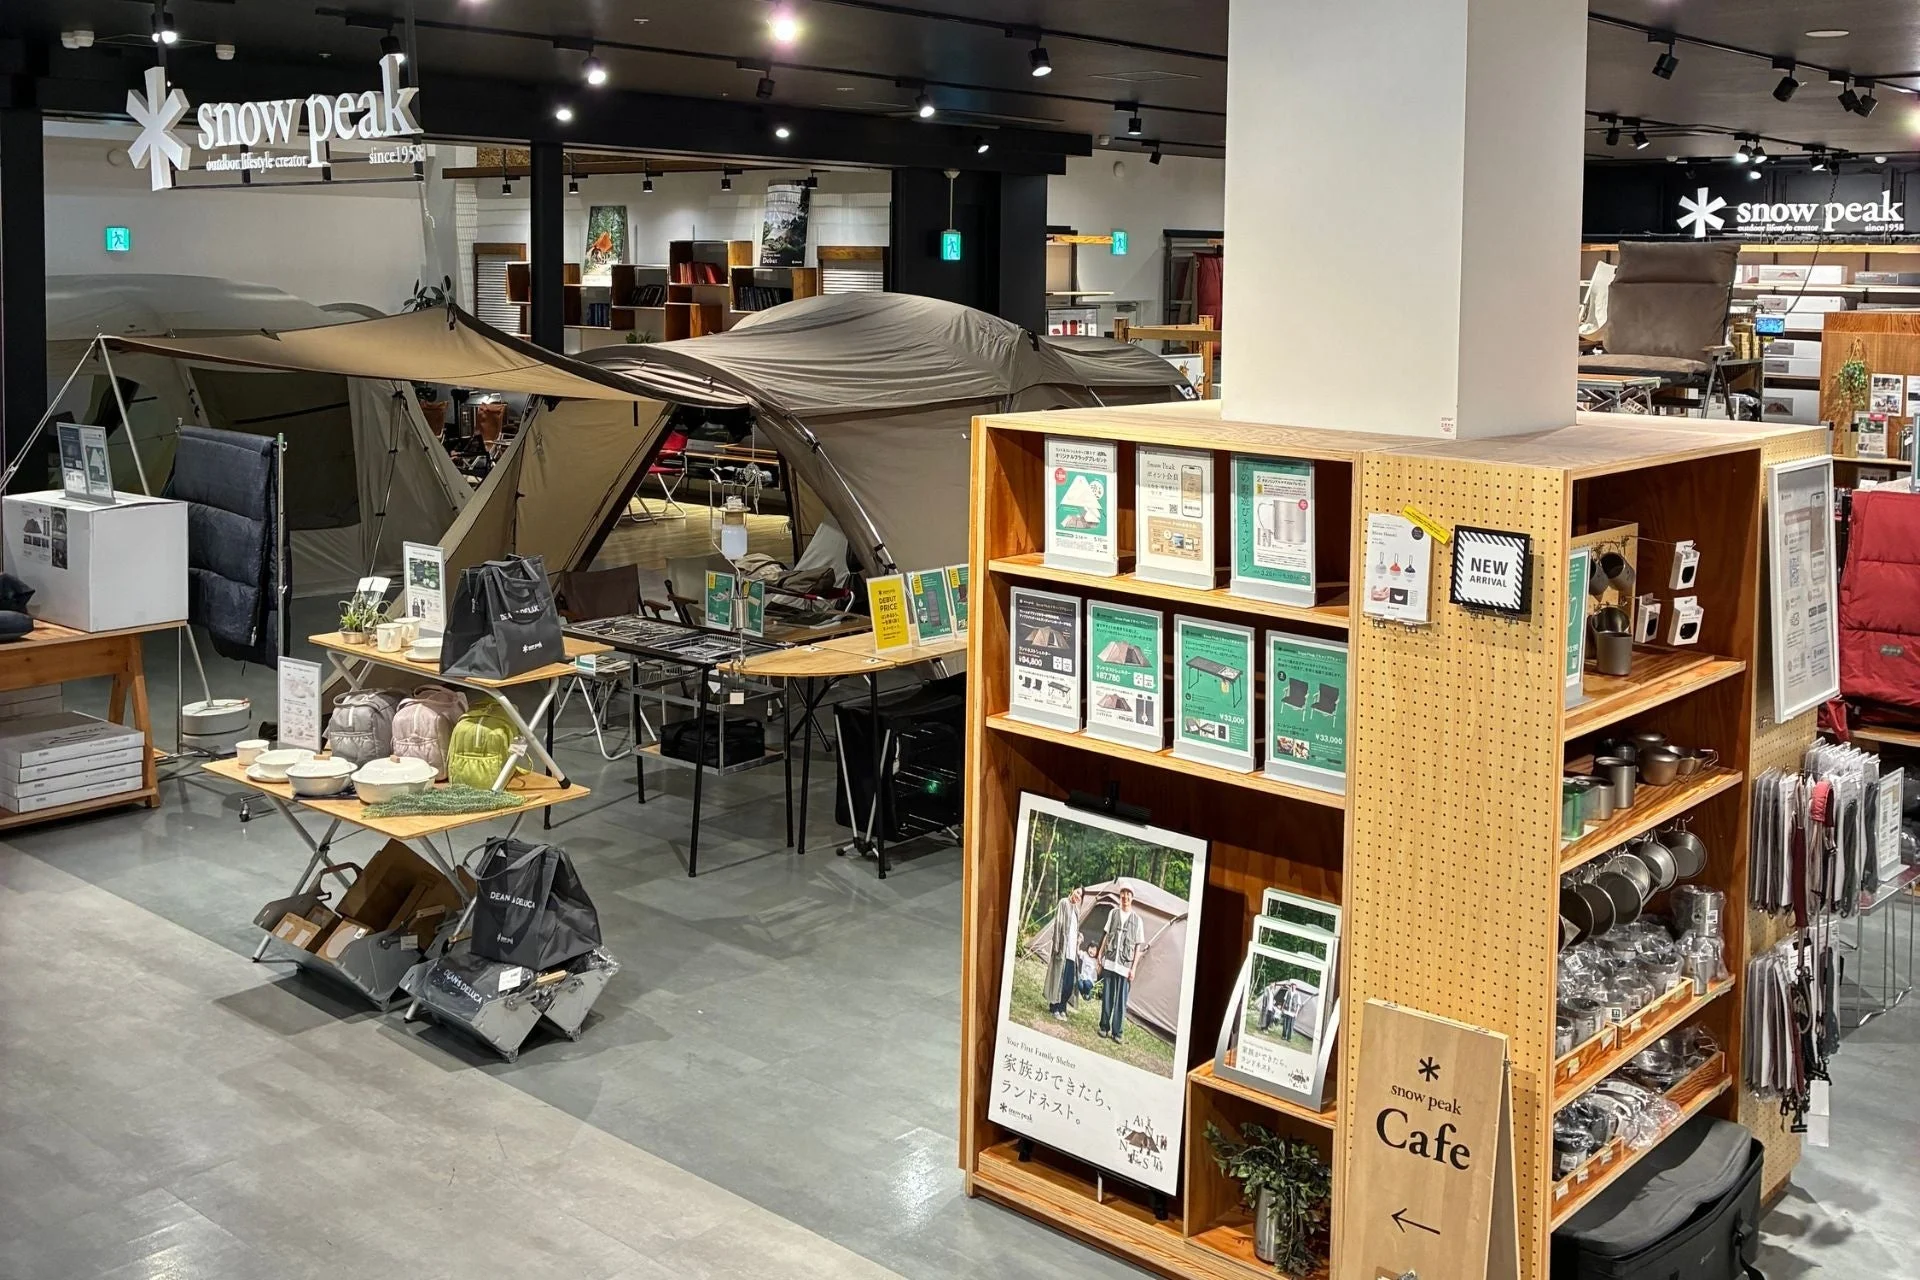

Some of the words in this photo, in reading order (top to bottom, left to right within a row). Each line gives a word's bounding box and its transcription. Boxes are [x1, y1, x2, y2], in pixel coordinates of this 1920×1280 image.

[198, 98, 298, 150] snow
[305, 54, 424, 168] peak
[206, 155, 240, 172] outdoor
[241, 152, 274, 174] lifestyle
[275, 154, 308, 169] creator
[1736, 202, 1819, 222] snow
[1823, 190, 1904, 232] peak
[1738, 224, 1765, 232] outdoor
[1766, 223, 1793, 233] lifestyle
[1794, 224, 1819, 232] creator
[1470, 557, 1508, 576] NEW
[1469, 576, 1507, 588] ARRIVAL
[879, 595, 896, 605] DEBUT
[880, 602, 898, 612] PRICE
[490, 891, 511, 901] DEAN
[515, 897, 536, 909] DELUCA
[460, 982, 483, 1004] DELUCA
[1006, 1036, 1019, 1049] Your
[1020, 1041, 1033, 1054] First
[1034, 1047, 1054, 1063] Family
[1055, 1054, 1076, 1069] Shelter
[1003, 1053, 1112, 1111] 家族ができたら、
[1001, 1079, 1081, 1125] ランドネスト。
[1390, 1083, 1425, 1103] snow
[1427, 1095, 1462, 1116] peak
[1008, 1107, 1020, 1117] snow
[1020, 1110, 1033, 1123] peak
[1376, 1107, 1471, 1170] Cafe
